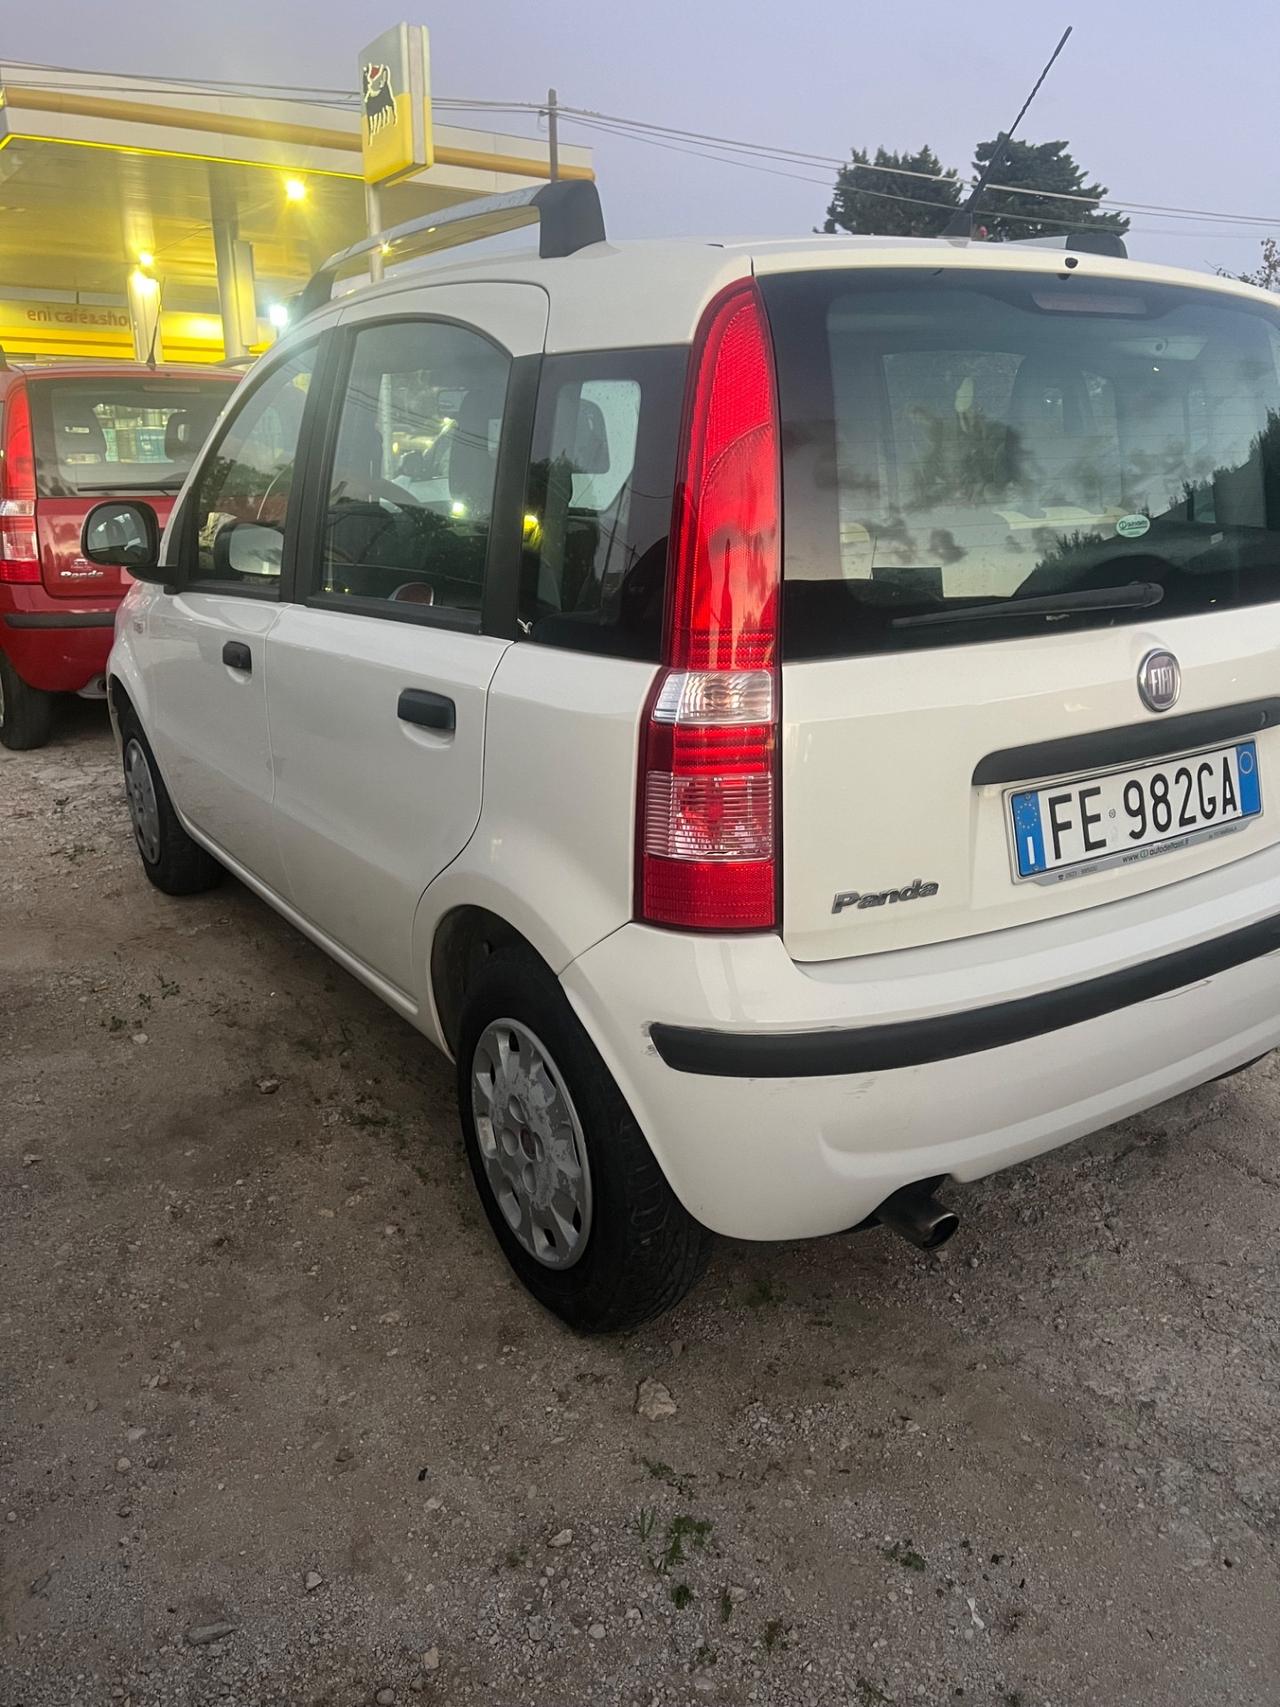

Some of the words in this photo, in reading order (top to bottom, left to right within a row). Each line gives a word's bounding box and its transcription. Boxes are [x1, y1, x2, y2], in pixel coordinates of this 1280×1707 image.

[26, 308, 51, 321] eni
[1150, 667, 1173, 696] FIAT
[1047, 786, 1108, 860] FE
[1122, 756, 1238, 840] 982GA
[831, 878, 939, 914] Panda
